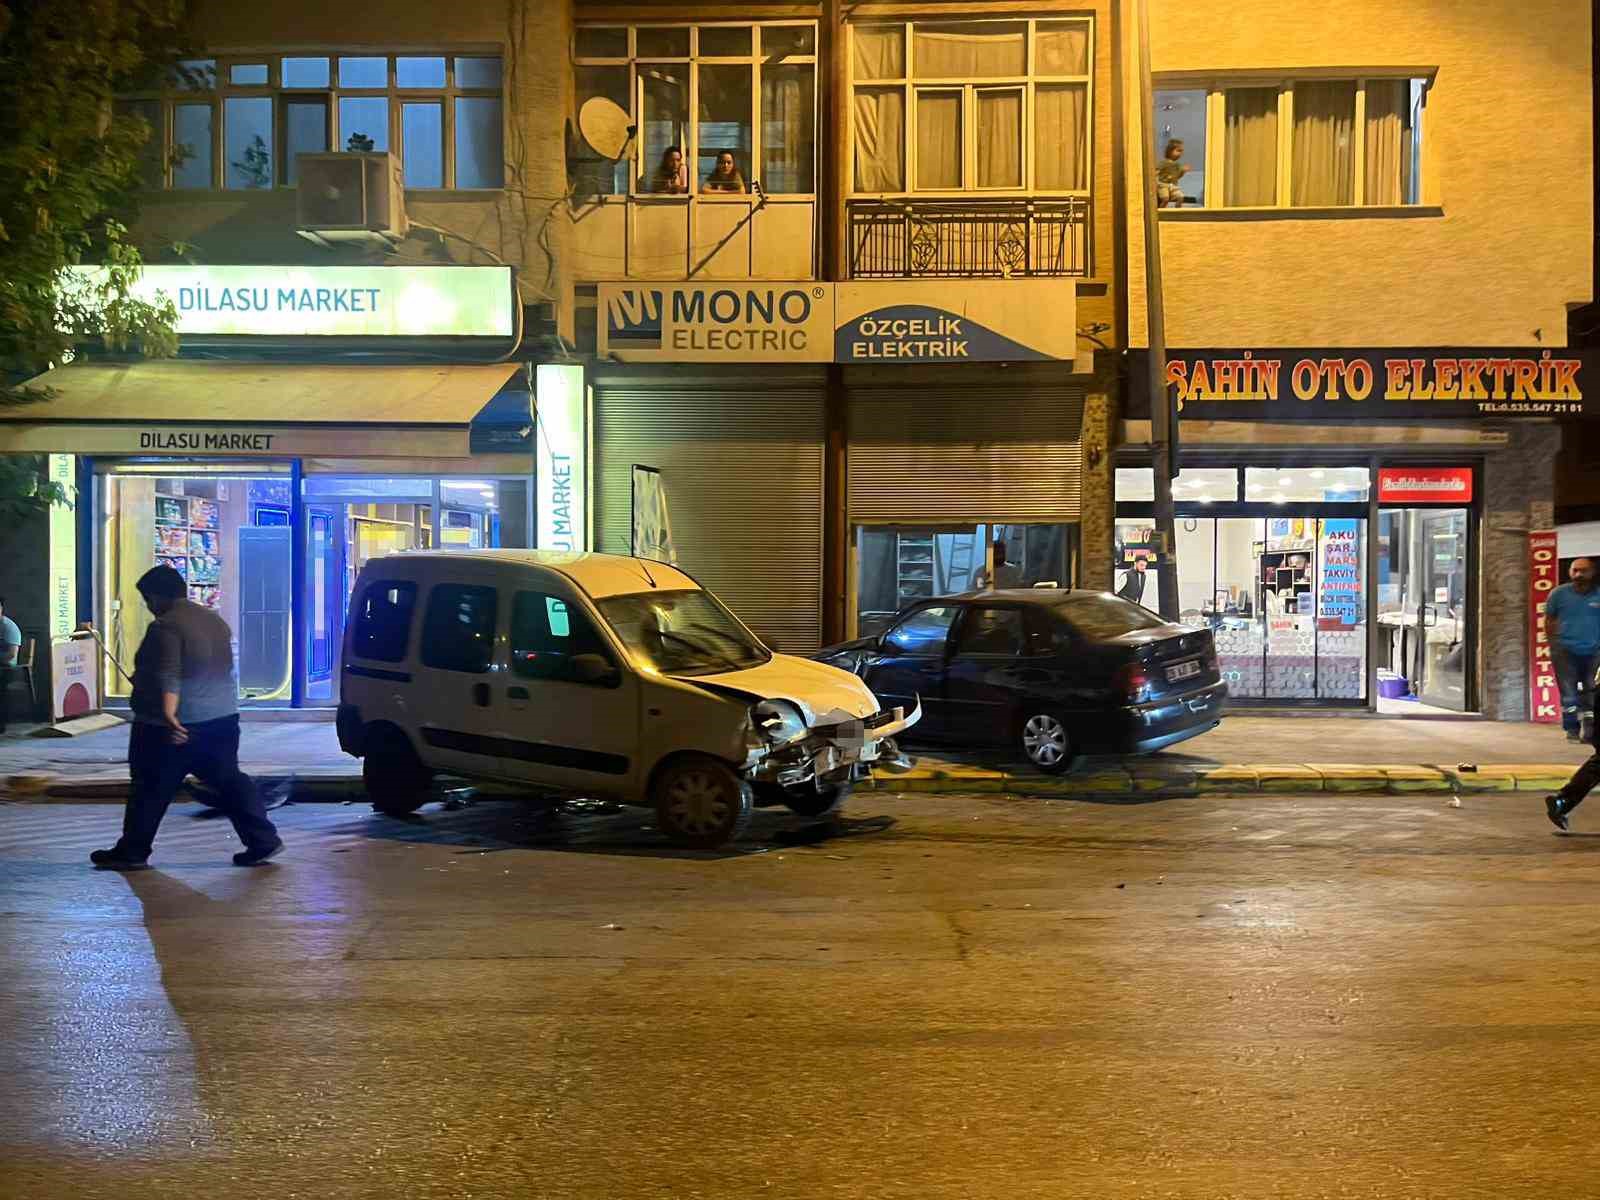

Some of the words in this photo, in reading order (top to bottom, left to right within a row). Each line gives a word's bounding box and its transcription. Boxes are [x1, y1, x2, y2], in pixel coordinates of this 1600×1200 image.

[277, 288, 380, 311] MARKET
[672, 290, 811, 324] MONO
[859, 316, 962, 339] ÖZÇELİK
[672, 329, 808, 350] ELECTRIC
[852, 339, 969, 358] ELEKTRİK
[1166, 351, 1280, 411] ŞAHİN
[1292, 359, 1373, 400] OTO
[1384, 350, 1582, 400] ELEKTRİK
[140, 432, 200, 448] DILASU
[204, 433, 273, 449] MARKET
[552, 451, 571, 535] MARKET
[1533, 549, 1553, 591] OTO
